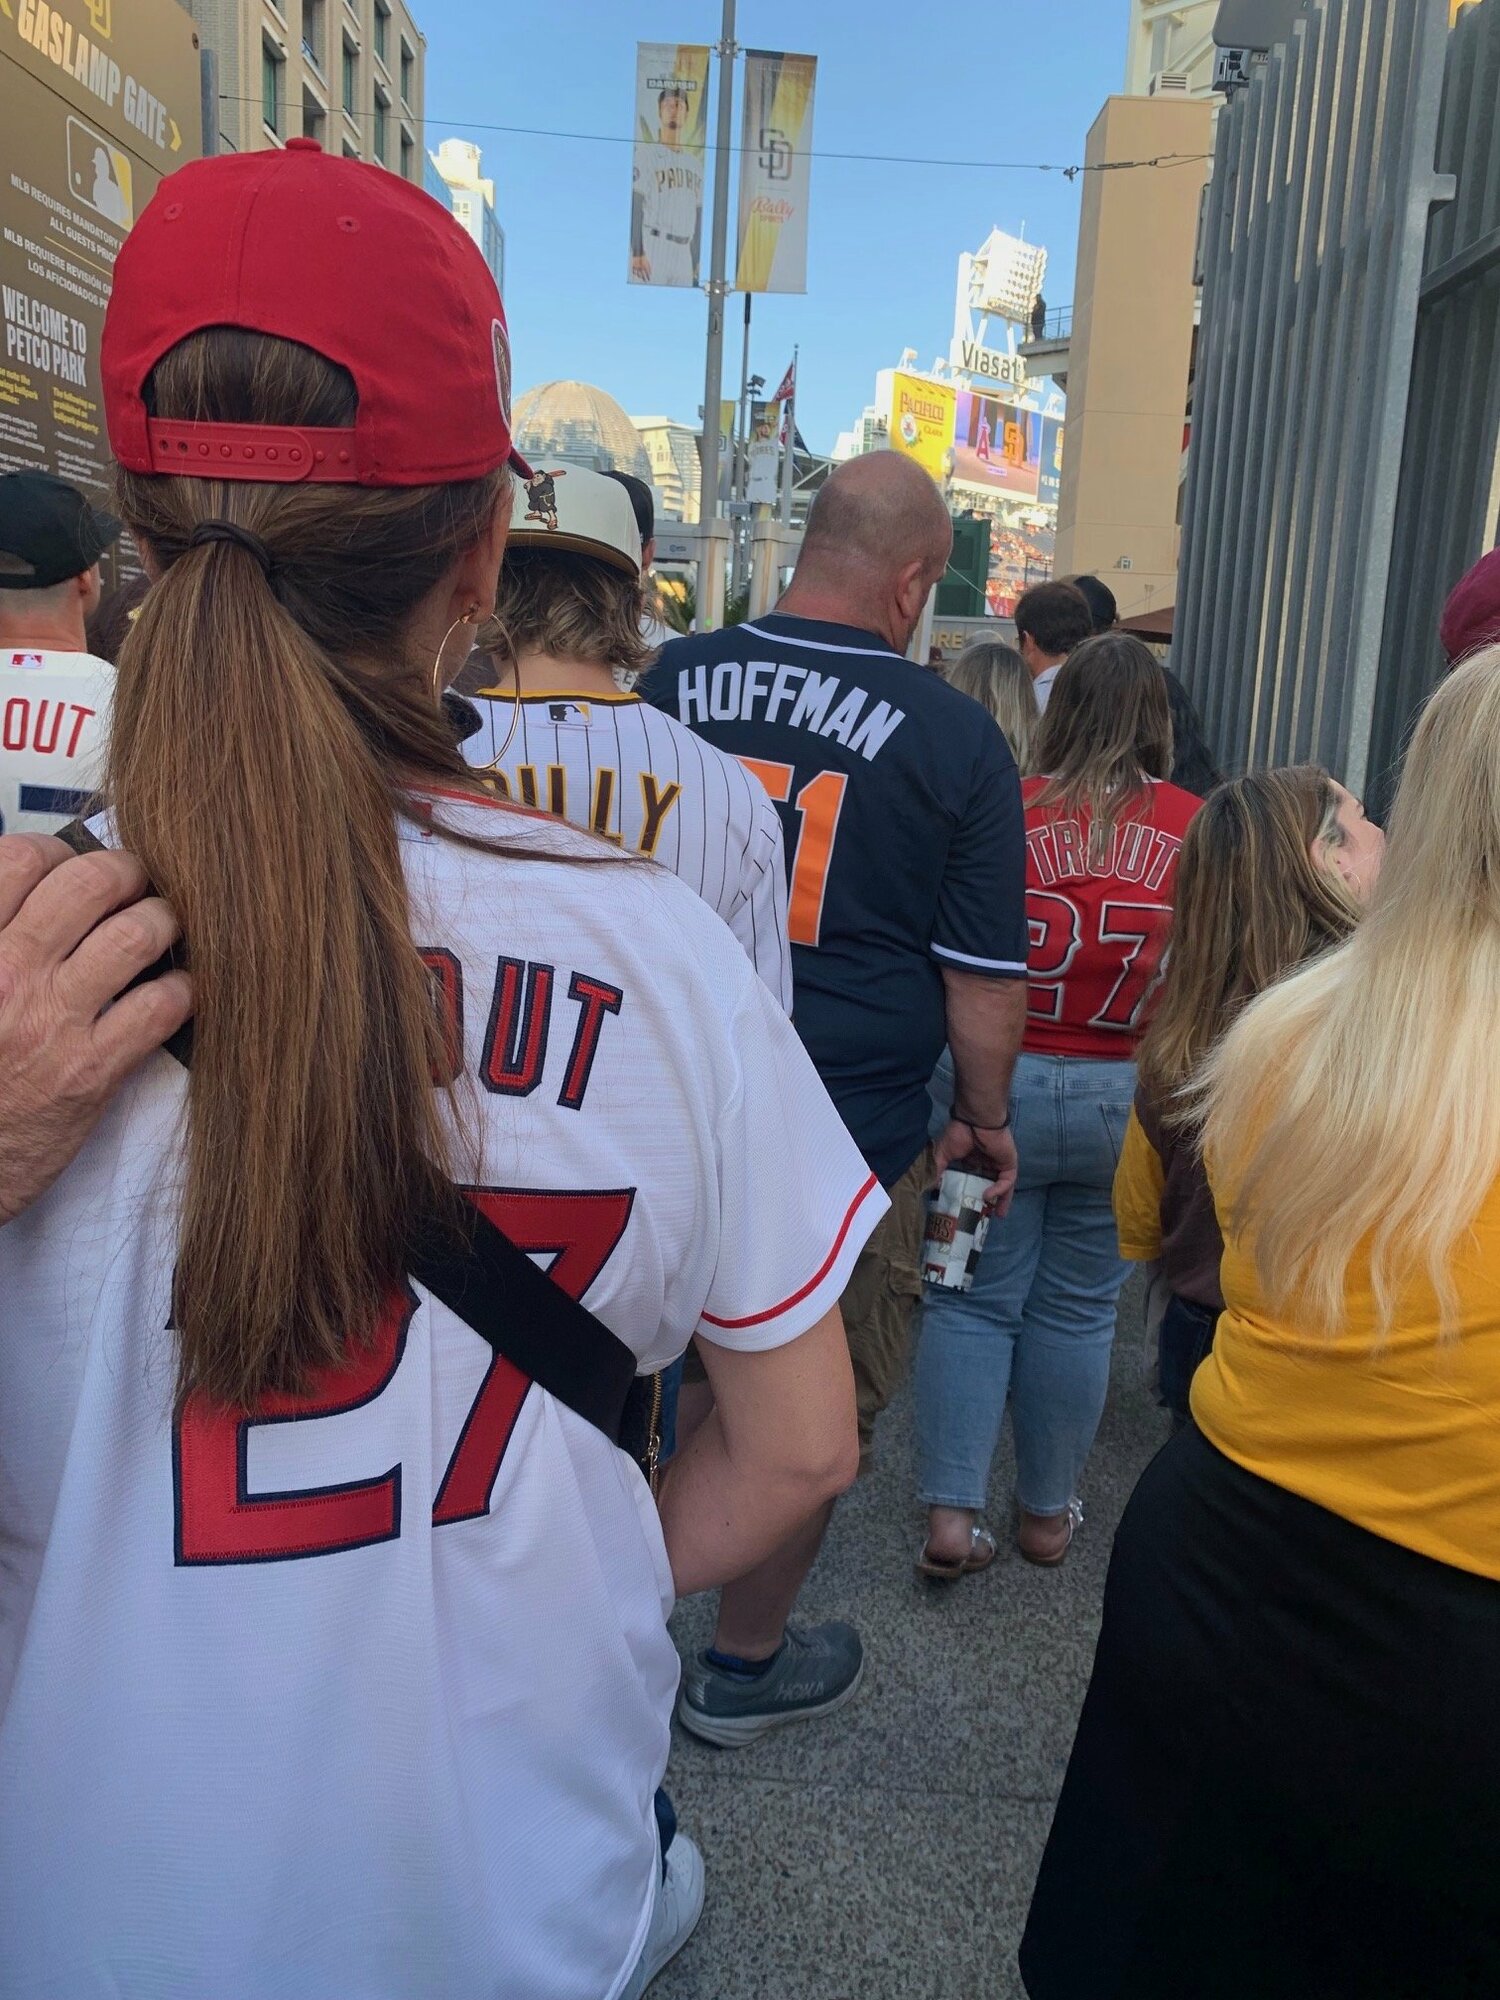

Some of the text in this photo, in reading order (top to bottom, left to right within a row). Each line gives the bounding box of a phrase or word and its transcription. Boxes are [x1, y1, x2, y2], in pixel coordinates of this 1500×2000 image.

[18, 0, 121, 108] GASLAMP
[123, 75, 168, 150] GATE
[758, 128, 793, 181] SD
[11, 173, 119, 249] MLB REQUIRES MANDATORY
[50, 216, 66, 234] ALL
[66, 226, 96, 252] GUESTS
[4, 227, 23, 247] MLB
[24, 239, 66, 270] REQUIERE
[66, 261, 102, 291] REVISIÓN
[28, 259, 45, 277] LOS
[46, 269, 98, 306] AFICIONADOS
[2, 284, 87, 354] WELCOME TO
[6, 322, 87, 388] PETCO PARK
[962, 340, 1019, 382] Viasat
[678, 660, 906, 762] HOFFMAN
[1027, 819, 1184, 891] TROUT
[1026, 888, 1174, 1029] 27
